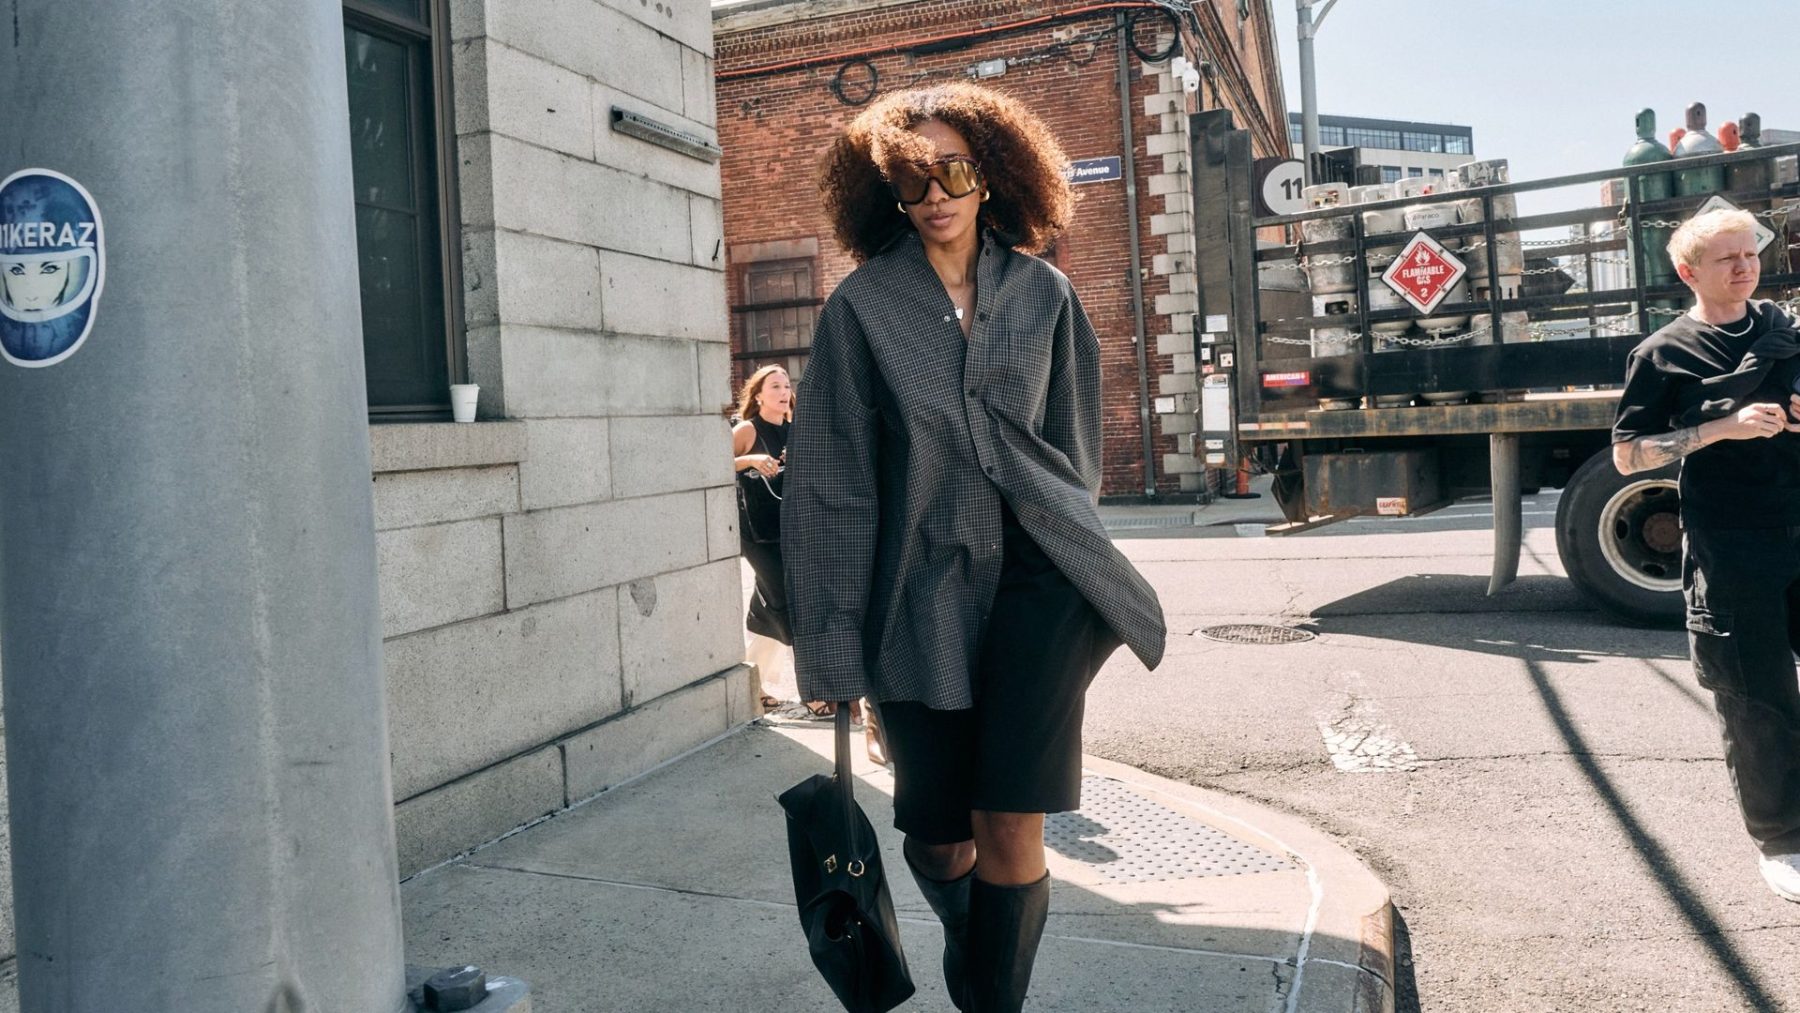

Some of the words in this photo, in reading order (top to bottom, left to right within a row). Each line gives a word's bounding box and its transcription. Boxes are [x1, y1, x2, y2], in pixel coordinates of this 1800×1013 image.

[1076, 166, 1110, 177] Avenue
[1280, 178, 1303, 200] 11
[1402, 265, 1445, 279] FLAMMABLE
[1416, 275, 1431, 285] GAS
[1420, 287, 1428, 298] 2
